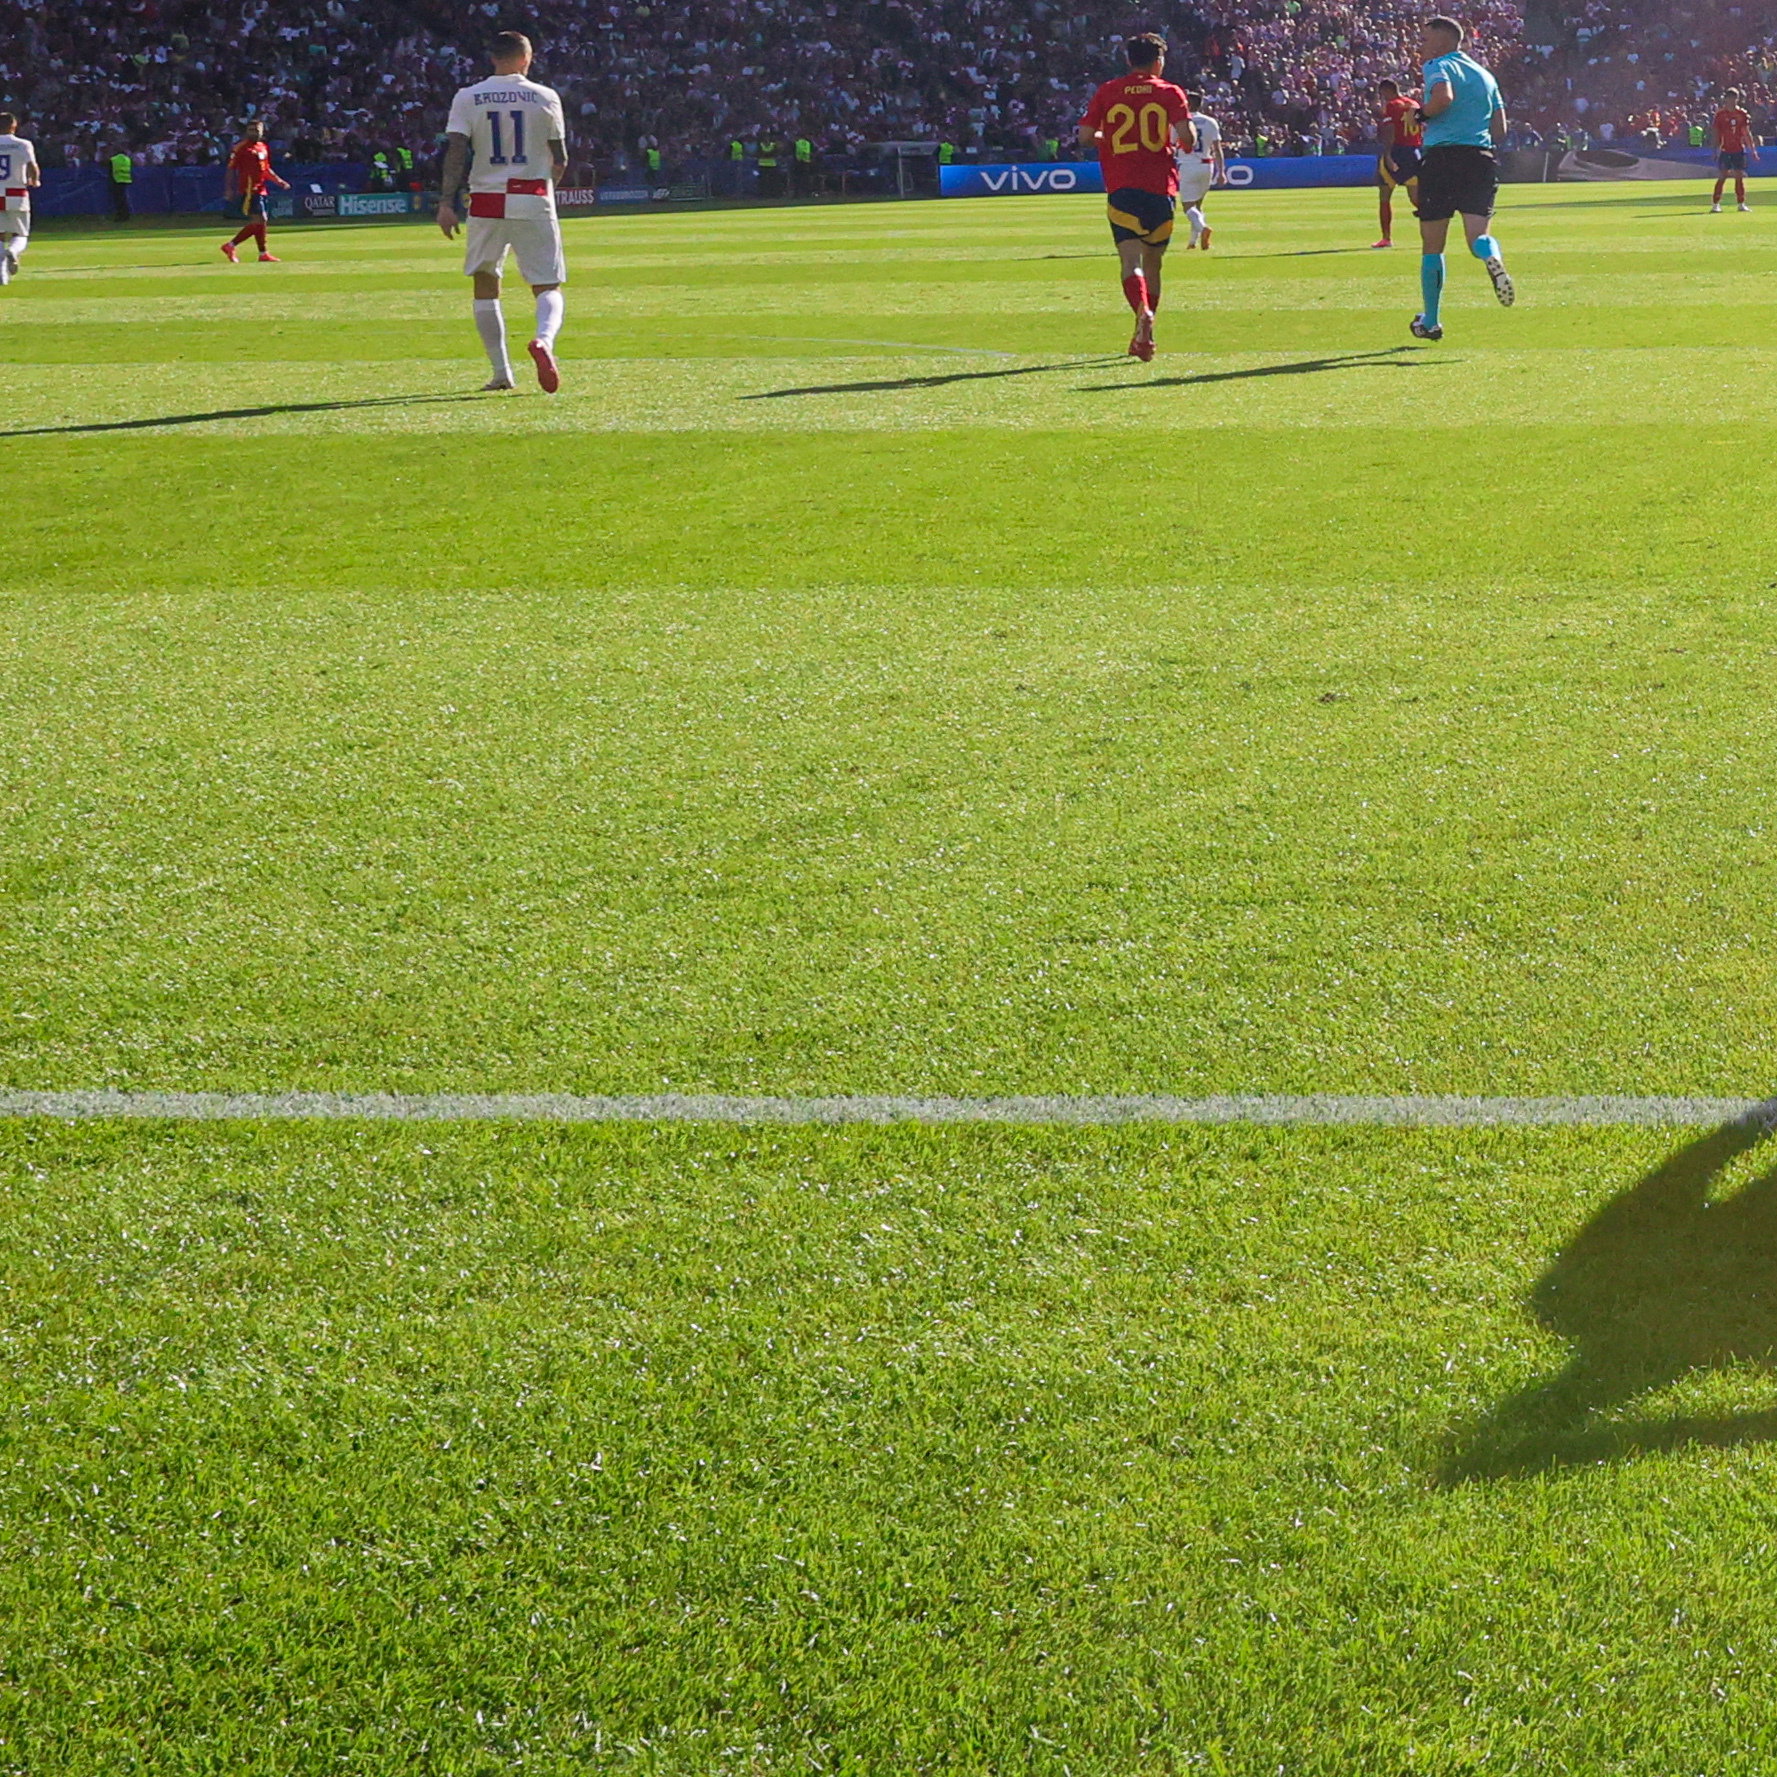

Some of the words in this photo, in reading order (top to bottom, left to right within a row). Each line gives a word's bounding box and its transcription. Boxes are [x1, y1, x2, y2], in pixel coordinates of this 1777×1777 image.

[487, 111, 538, 166] 11
[1107, 103, 1168, 154] 20
[980, 166, 1077, 191] vivo
[304, 196, 336, 212] QATAR
[339, 194, 407, 215] Hisense
[555, 190, 595, 205] TRAUSS
